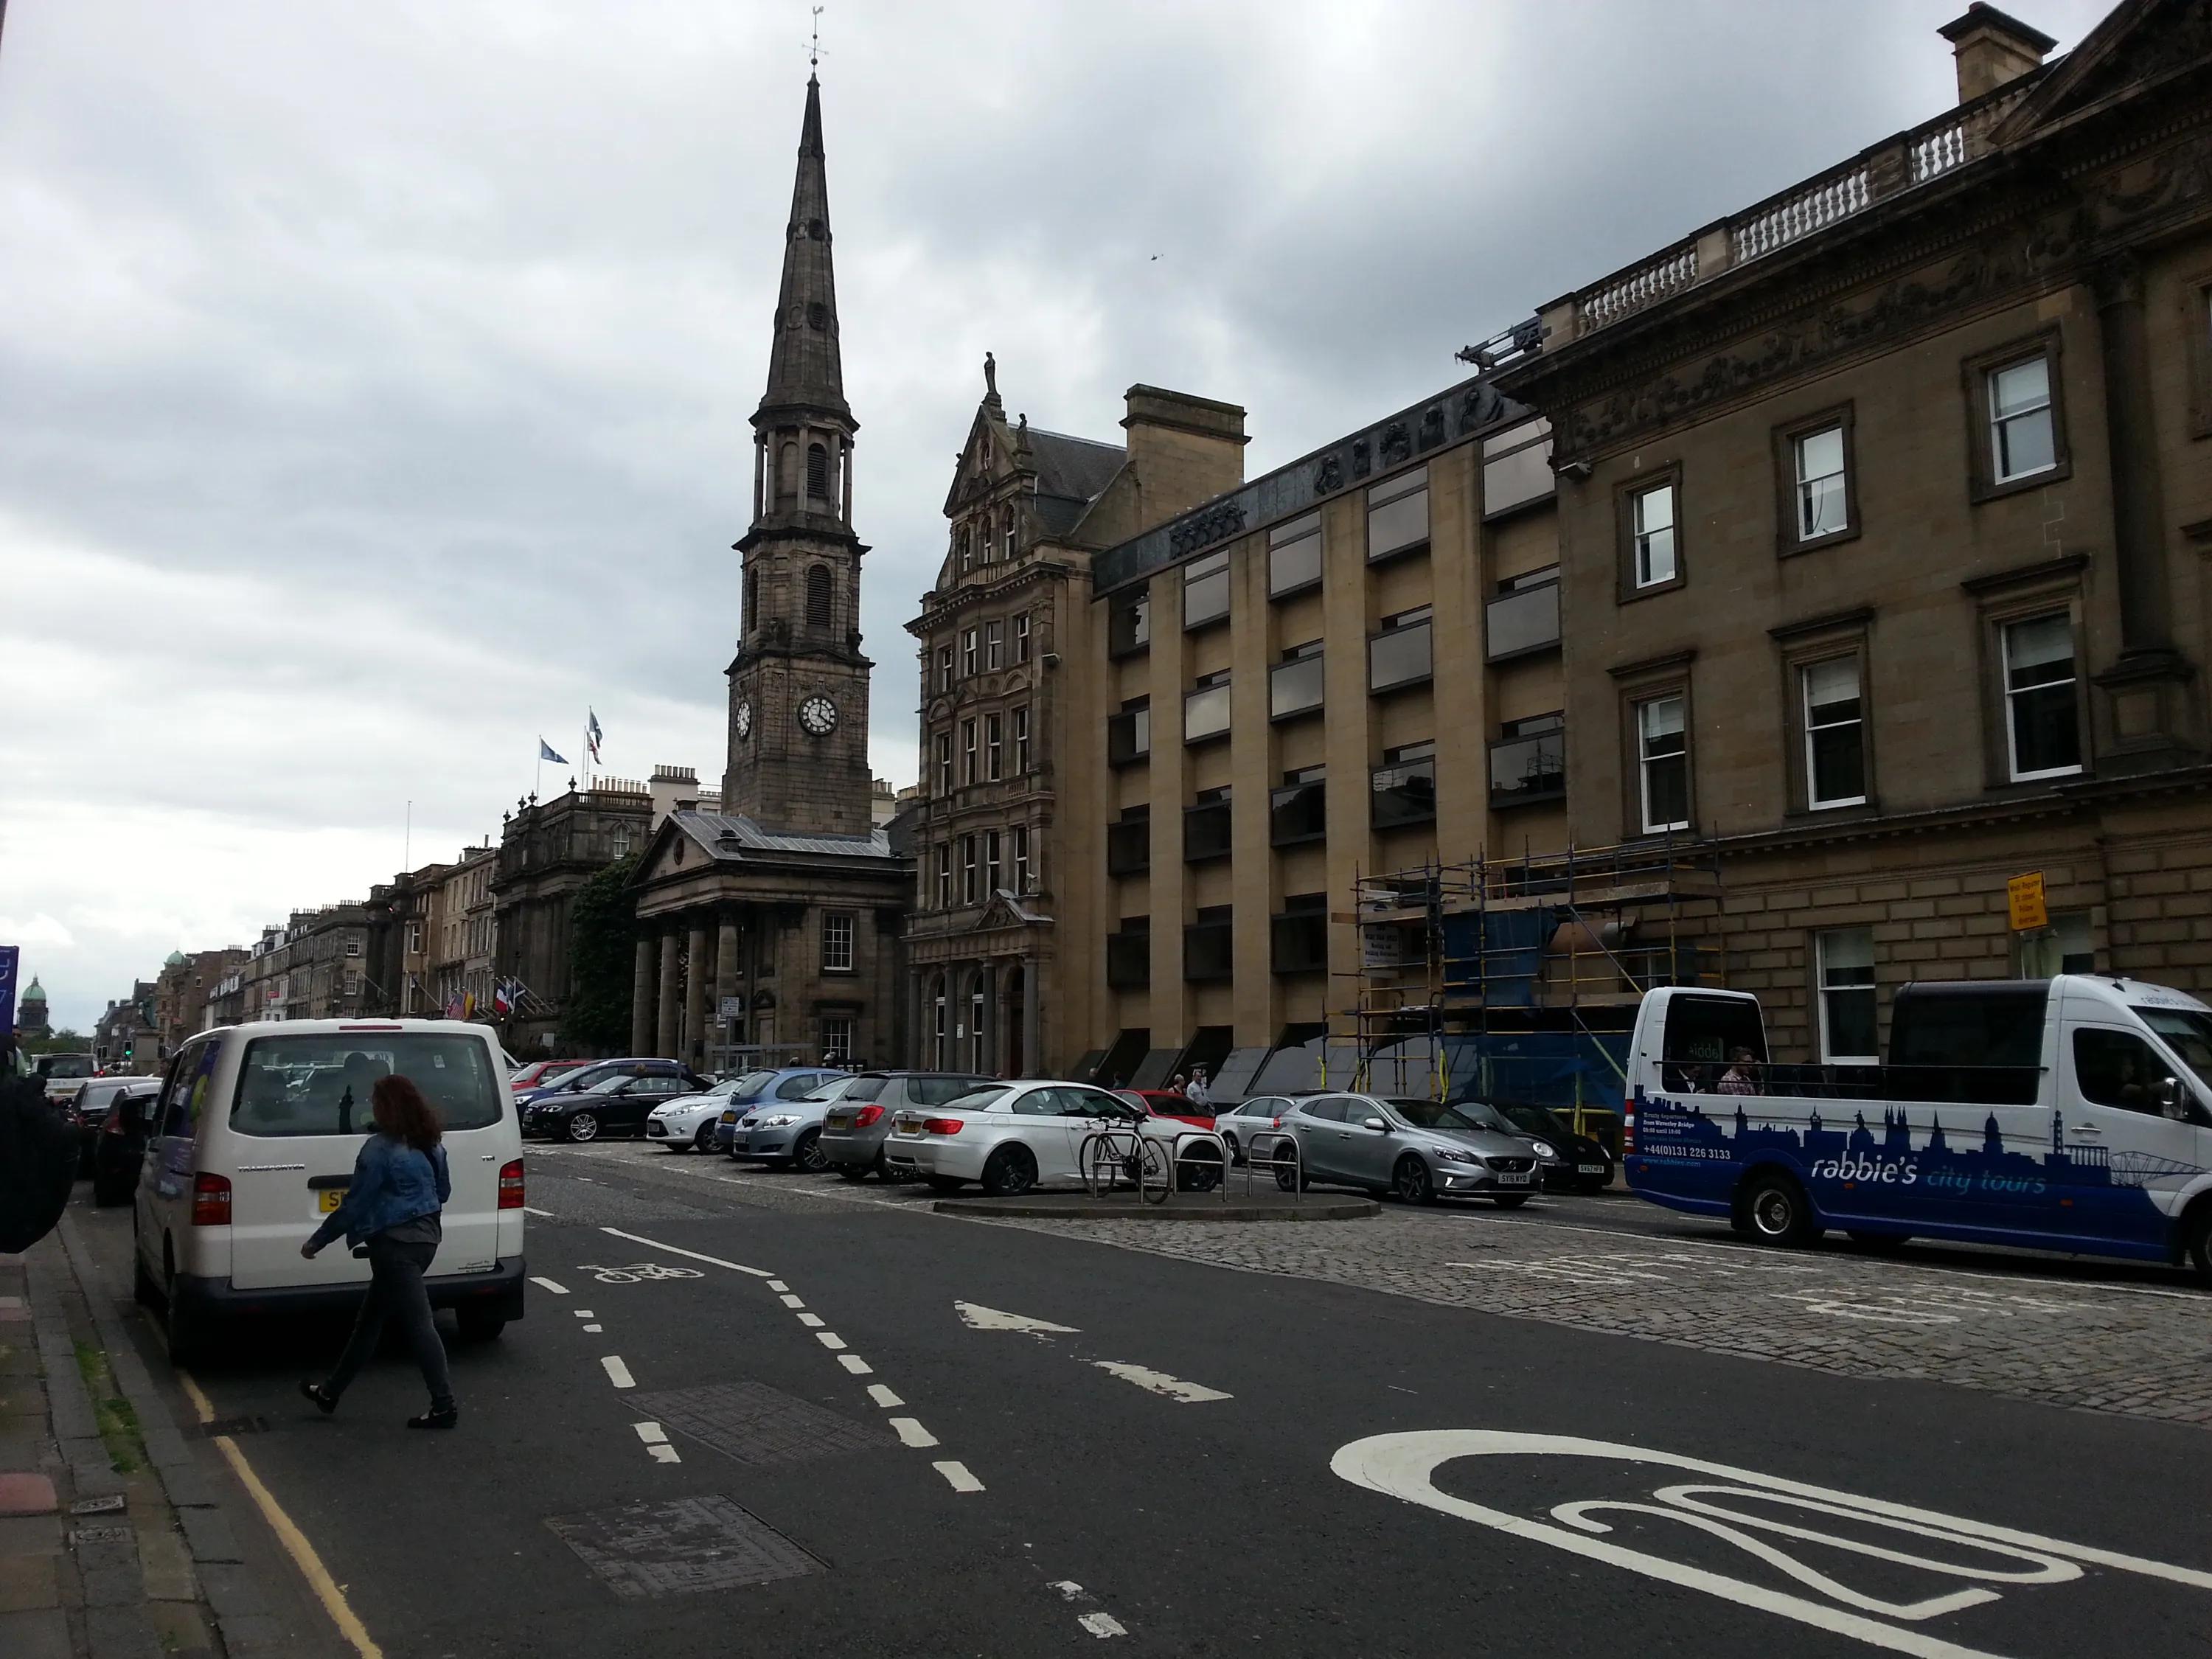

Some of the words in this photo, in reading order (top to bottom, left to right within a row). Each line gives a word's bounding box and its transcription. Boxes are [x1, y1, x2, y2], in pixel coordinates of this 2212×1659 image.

[1677, 1121, 1694, 1129] Bridge
[1644, 1144, 1687, 1158] +44(0)131
[1689, 1147, 1706, 1158] 226
[1708, 1149, 1731, 1160] 3133
[237, 1164, 305, 1172] TRANSPORTER
[1811, 1150, 1918, 1185] rabbie's
[1926, 1165, 1972, 1196] city
[1981, 1169, 2048, 1194] tours
[1550, 1484, 2084, 1621] 20
